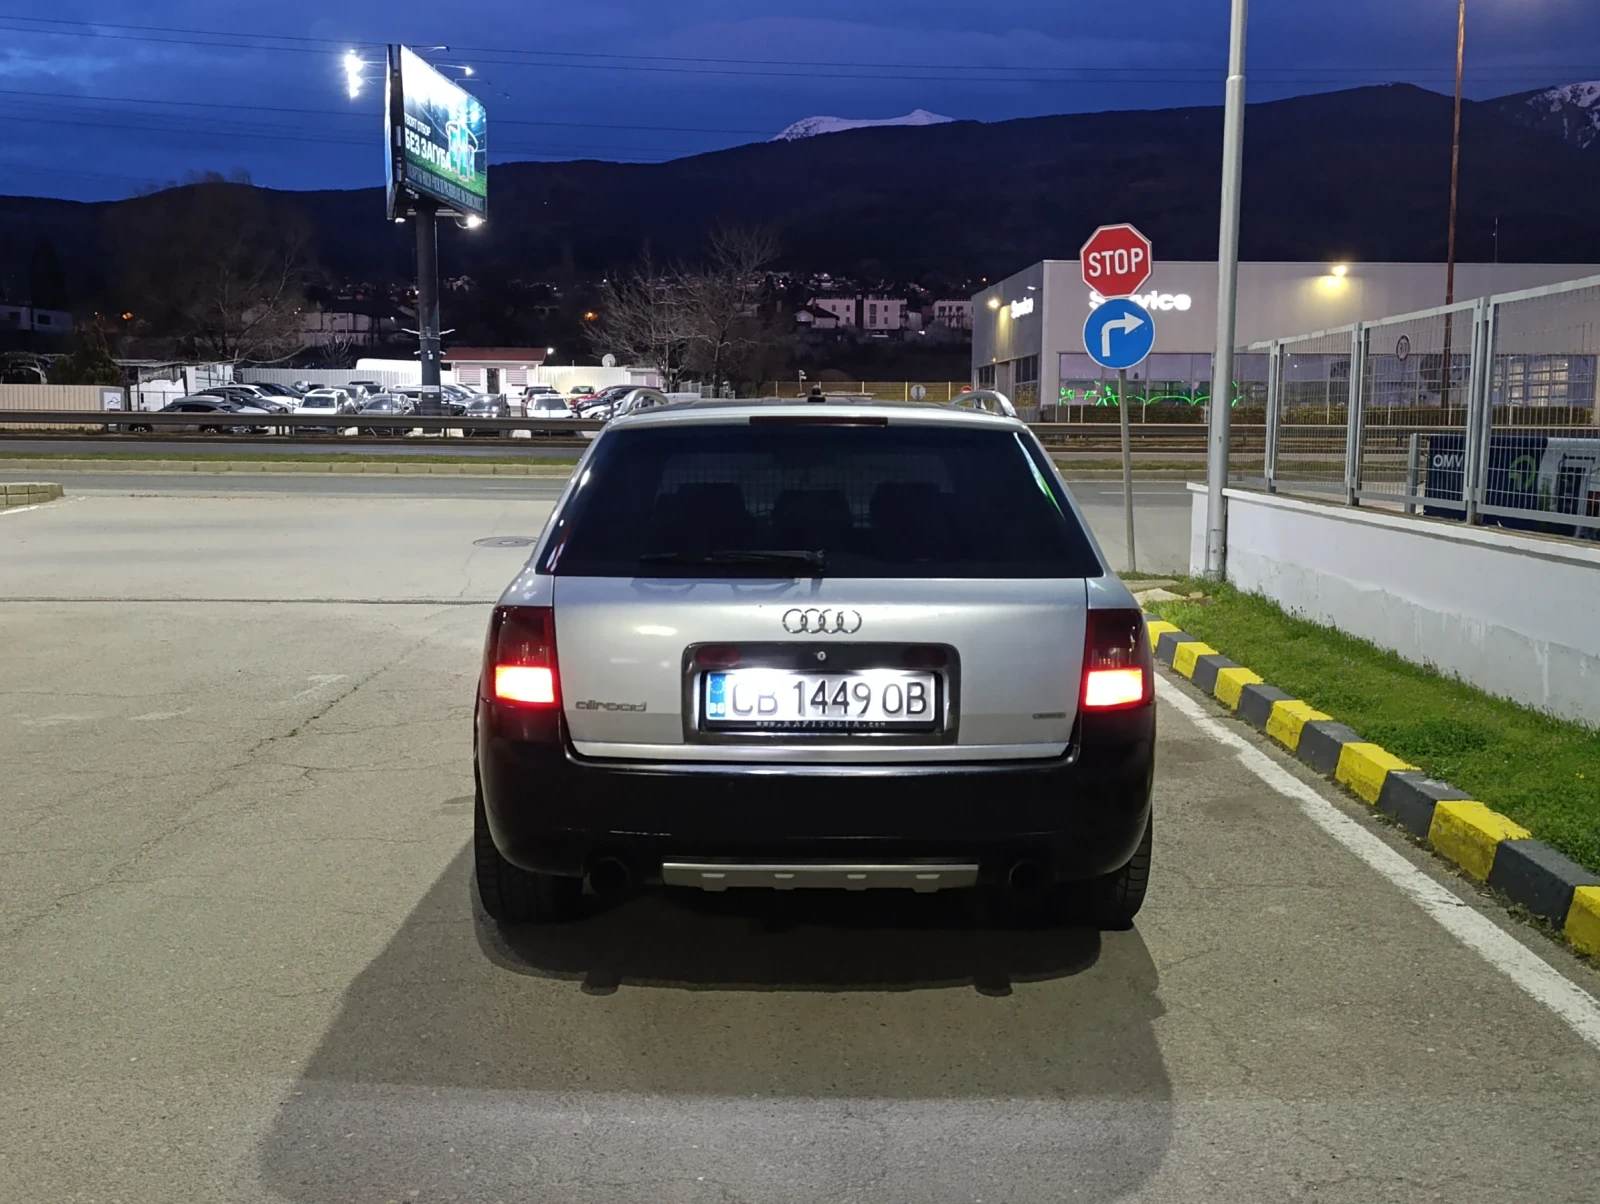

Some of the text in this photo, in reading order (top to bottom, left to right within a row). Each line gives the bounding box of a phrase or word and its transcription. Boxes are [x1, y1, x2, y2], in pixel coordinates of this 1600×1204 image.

[405, 127, 420, 156] БЕЗ
[1088, 247, 1144, 277] STOP
[1433, 454, 1464, 467] OMV
[575, 699, 647, 712] allroad
[732, 682, 779, 716] CB
[793, 680, 872, 717] 1449
